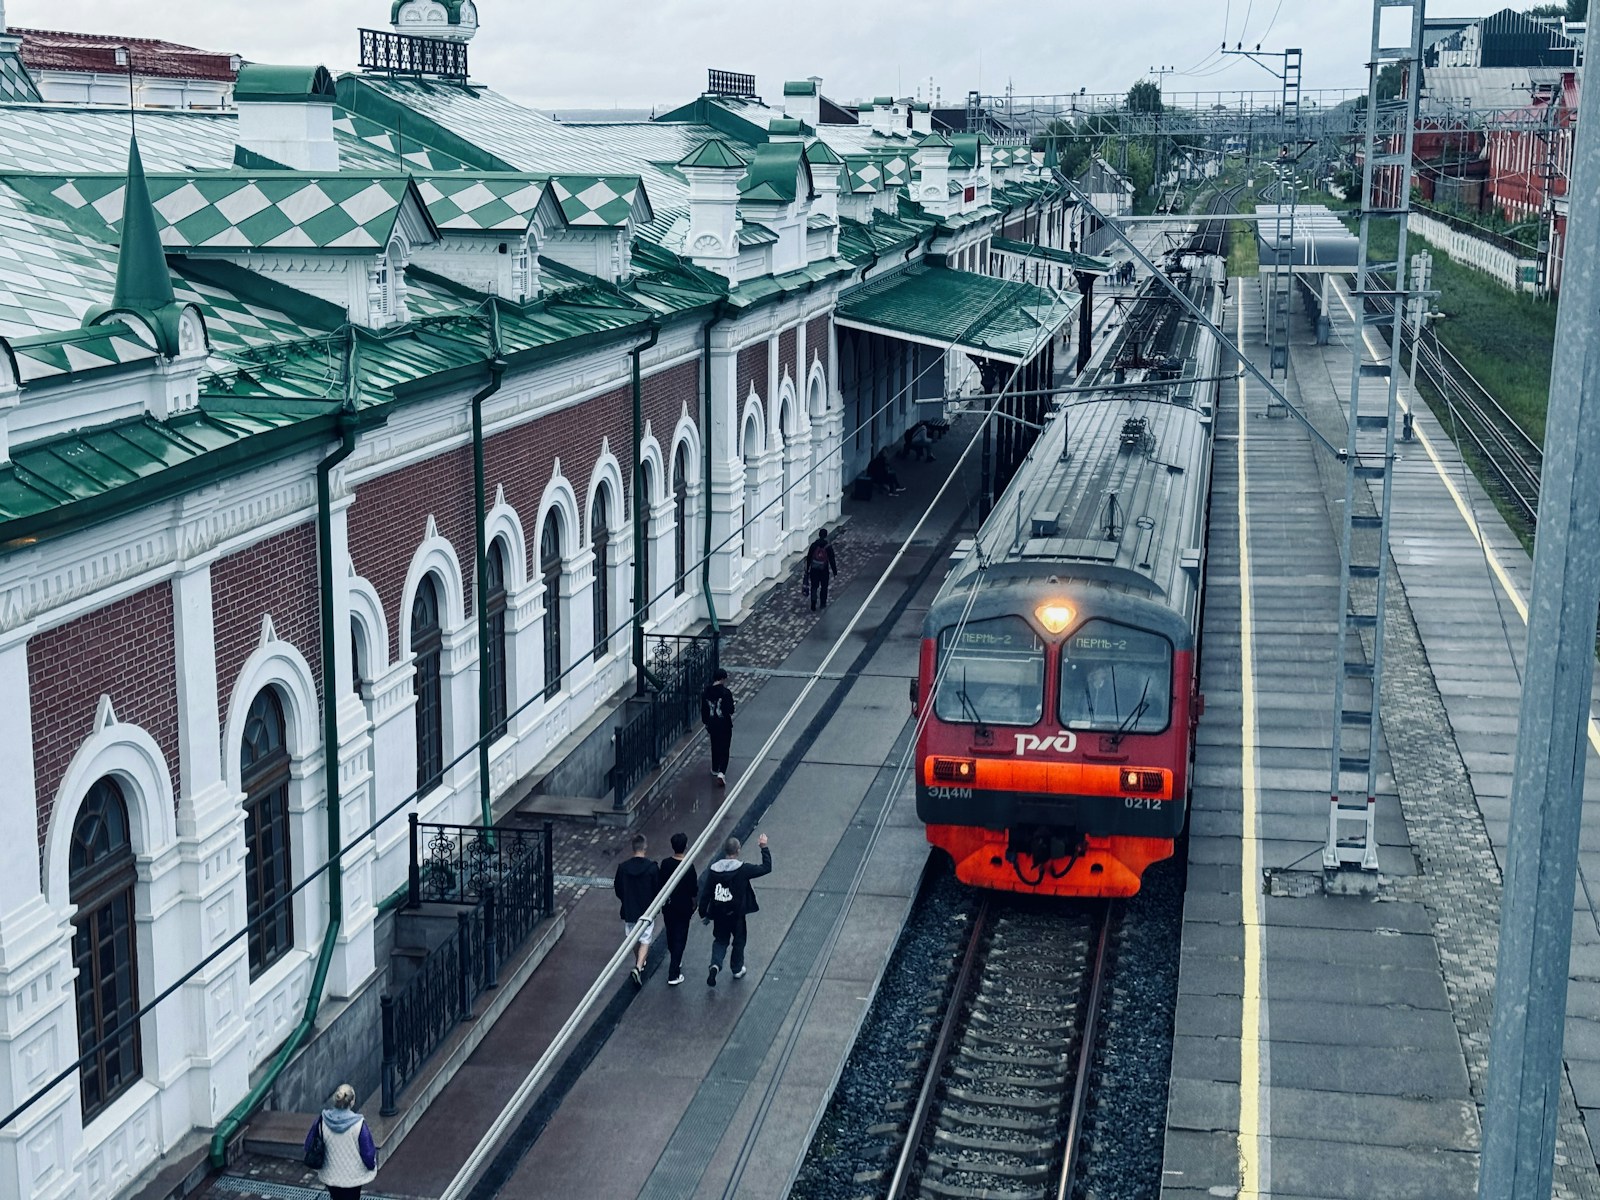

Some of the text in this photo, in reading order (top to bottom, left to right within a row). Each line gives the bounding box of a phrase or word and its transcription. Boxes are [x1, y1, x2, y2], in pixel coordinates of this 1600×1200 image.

[961, 632, 1012, 645] ПЕРМЬ-2
[1076, 637, 1127, 650] ПЕРМЬ-2
[928, 786, 973, 800] ЭД4М
[1124, 797, 1162, 811] 0212
